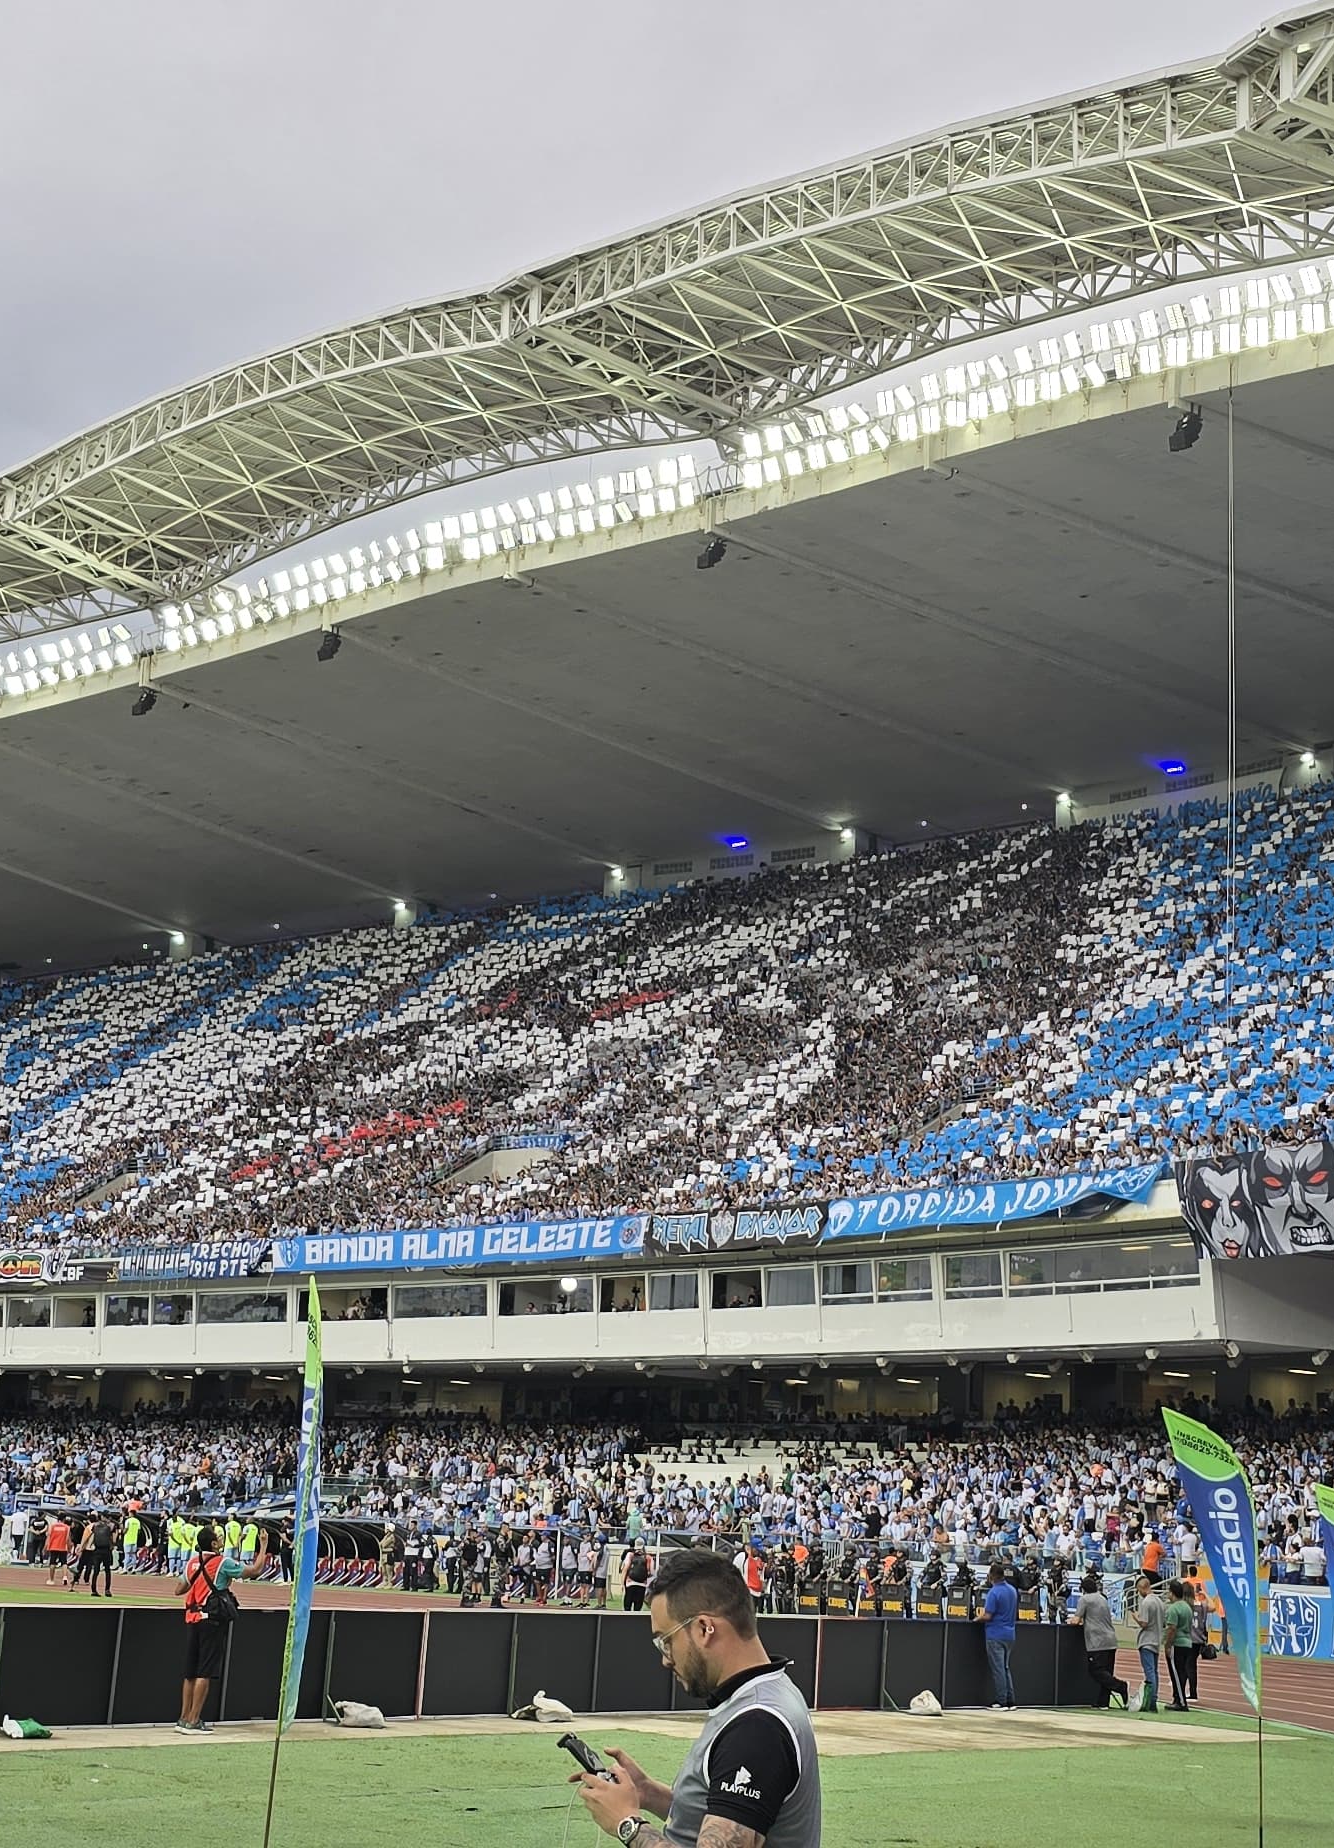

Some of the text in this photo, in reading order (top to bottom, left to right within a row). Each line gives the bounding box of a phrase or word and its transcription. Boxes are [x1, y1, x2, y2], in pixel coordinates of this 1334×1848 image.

[857, 1189, 995, 1231] TORCIDA
[191, 1241, 252, 1259] TRECHO
[305, 1219, 613, 1265] BANDA ALMA CELESTE
[189, 1260, 215, 1278] 1914
[218, 1259, 249, 1277] PTE
[1209, 1487, 1251, 1607] stácio
[720, 1781, 761, 1800] PLAYPLUS
